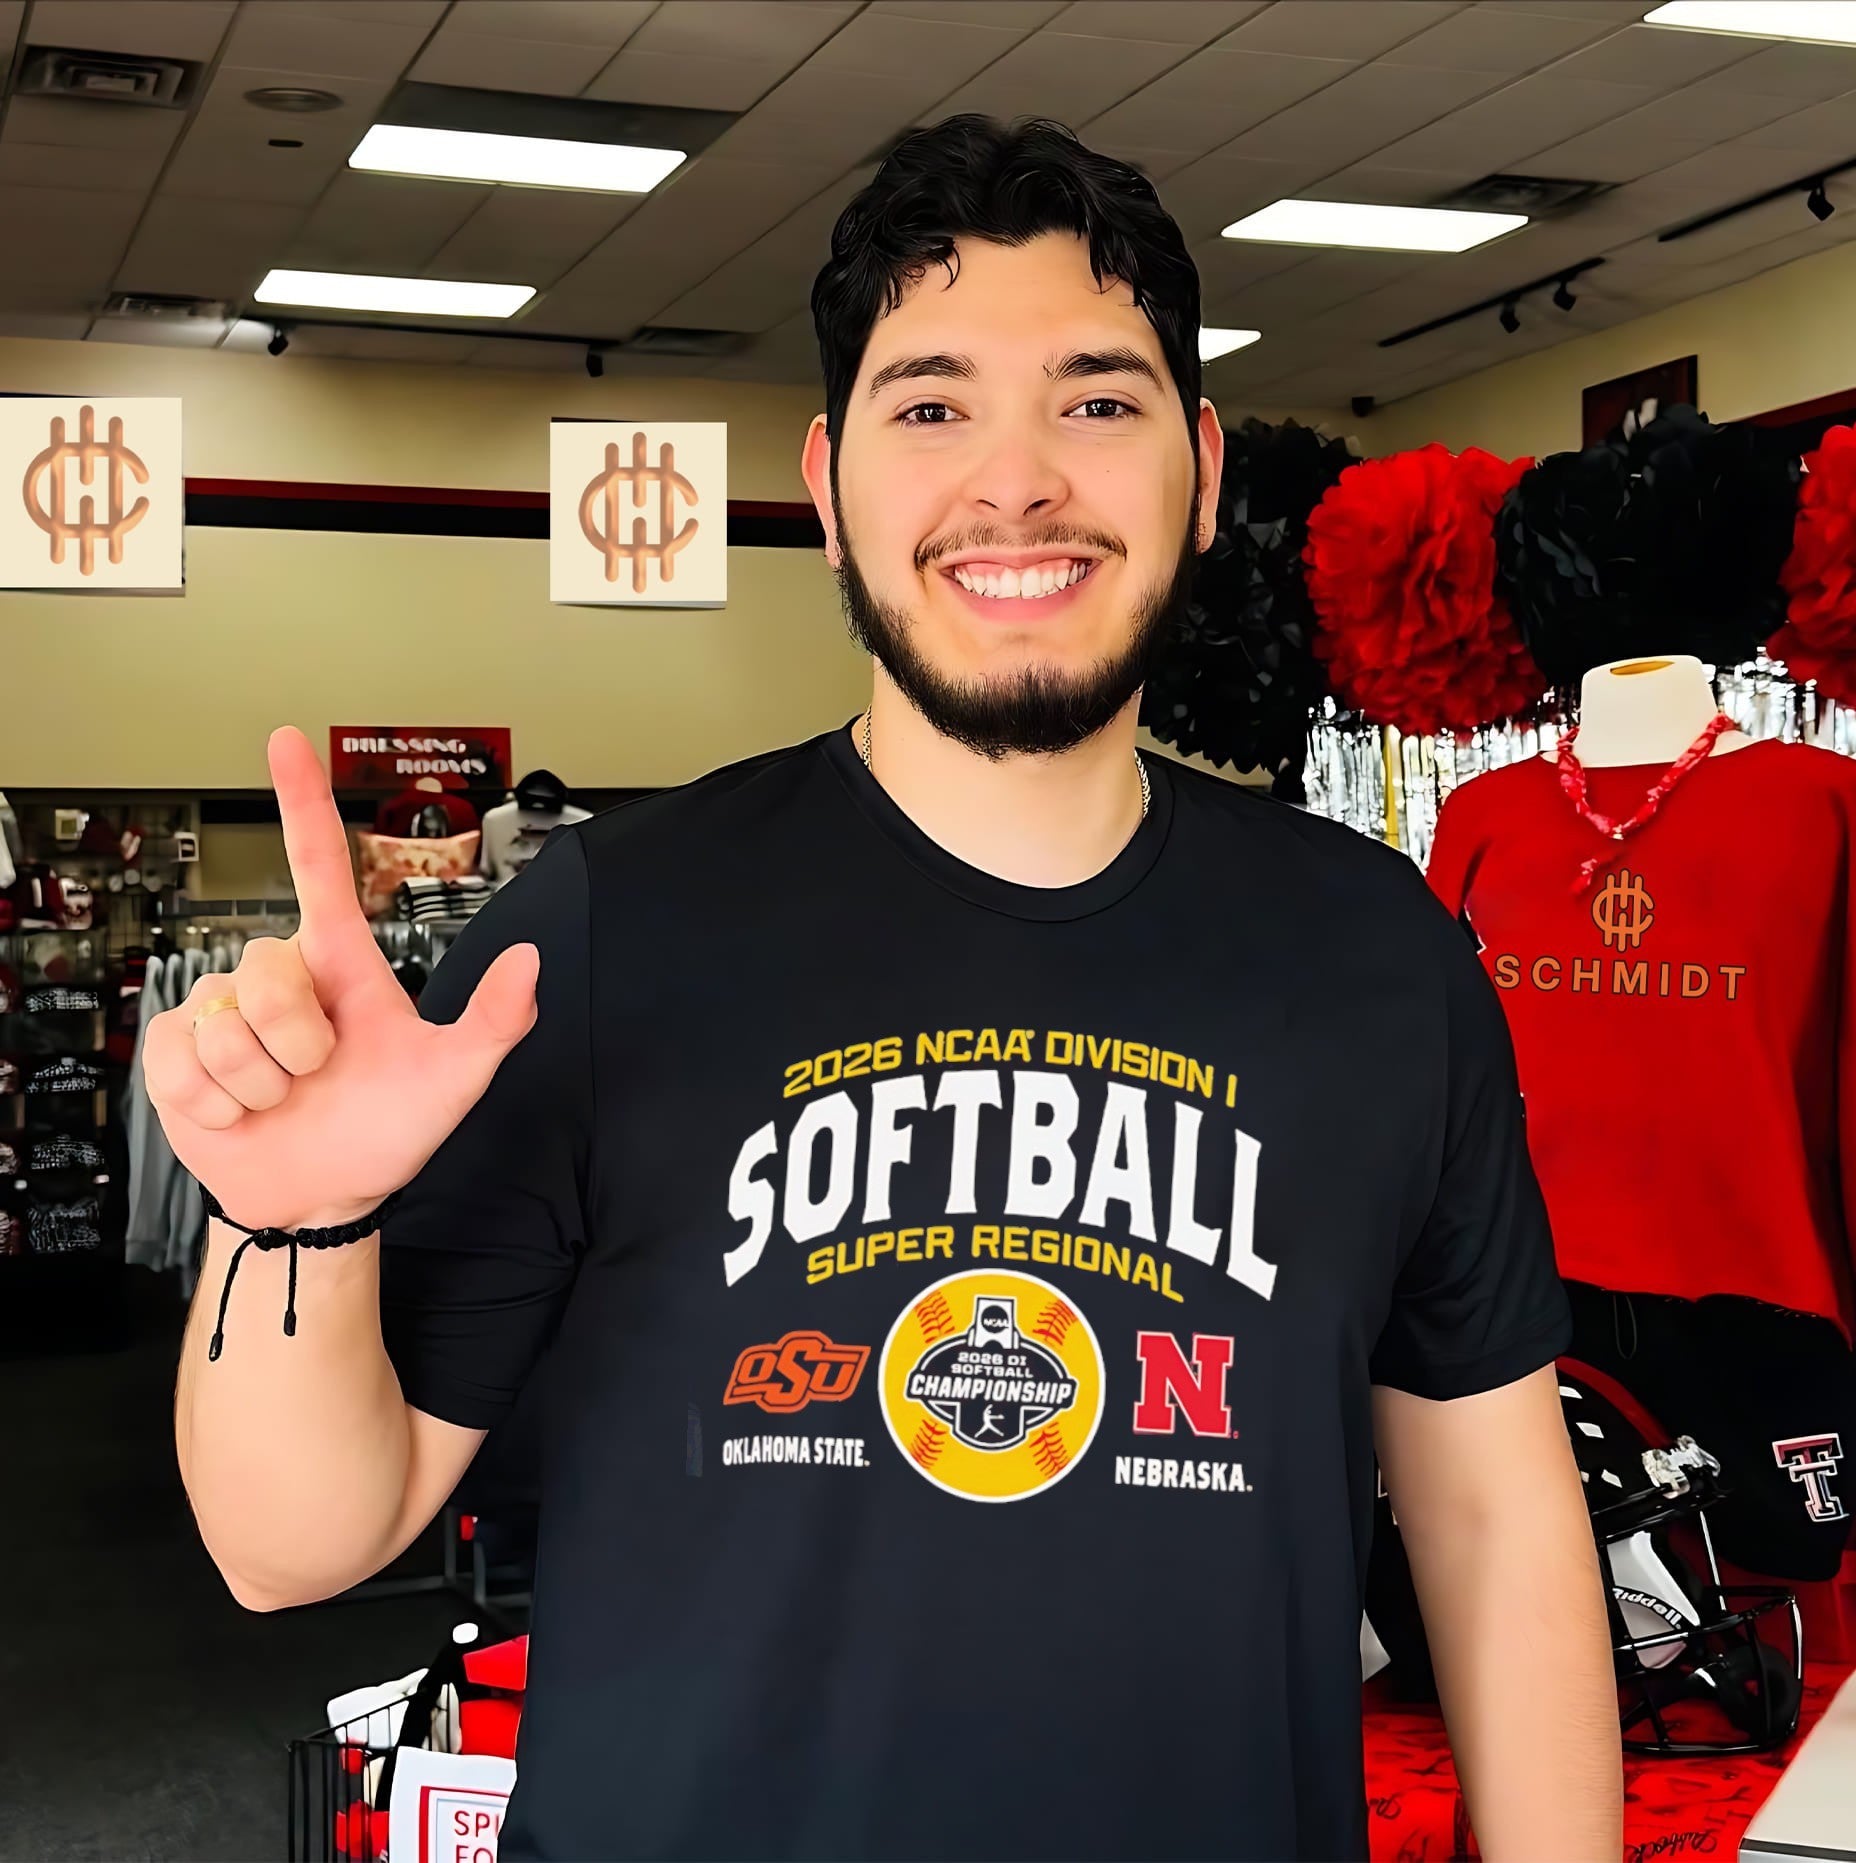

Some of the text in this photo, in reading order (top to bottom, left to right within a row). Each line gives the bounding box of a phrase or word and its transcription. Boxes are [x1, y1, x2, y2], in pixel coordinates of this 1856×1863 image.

[341, 737, 467, 754] DRESSING
[395, 758, 487, 775] ROOMS
[1494, 953, 1746, 1000] SCHMIDT
[783, 1036, 903, 1098] 2026
[1045, 1030, 1214, 1099] DIVISION
[1225, 1073, 1238, 1108] I
[723, 1069, 1278, 1301] SOFTBALL
[806, 1224, 1185, 1303] SUPER REGIONAL
[723, 1330, 871, 1413] OSU
[951, 1363, 1034, 1379] SOFTBALL
[957, 1351, 1027, 1367] 2026 DI
[910, 1373, 1073, 1405] CHAMPIONSHIP
[722, 1435, 812, 1466] OKLAHOMA
